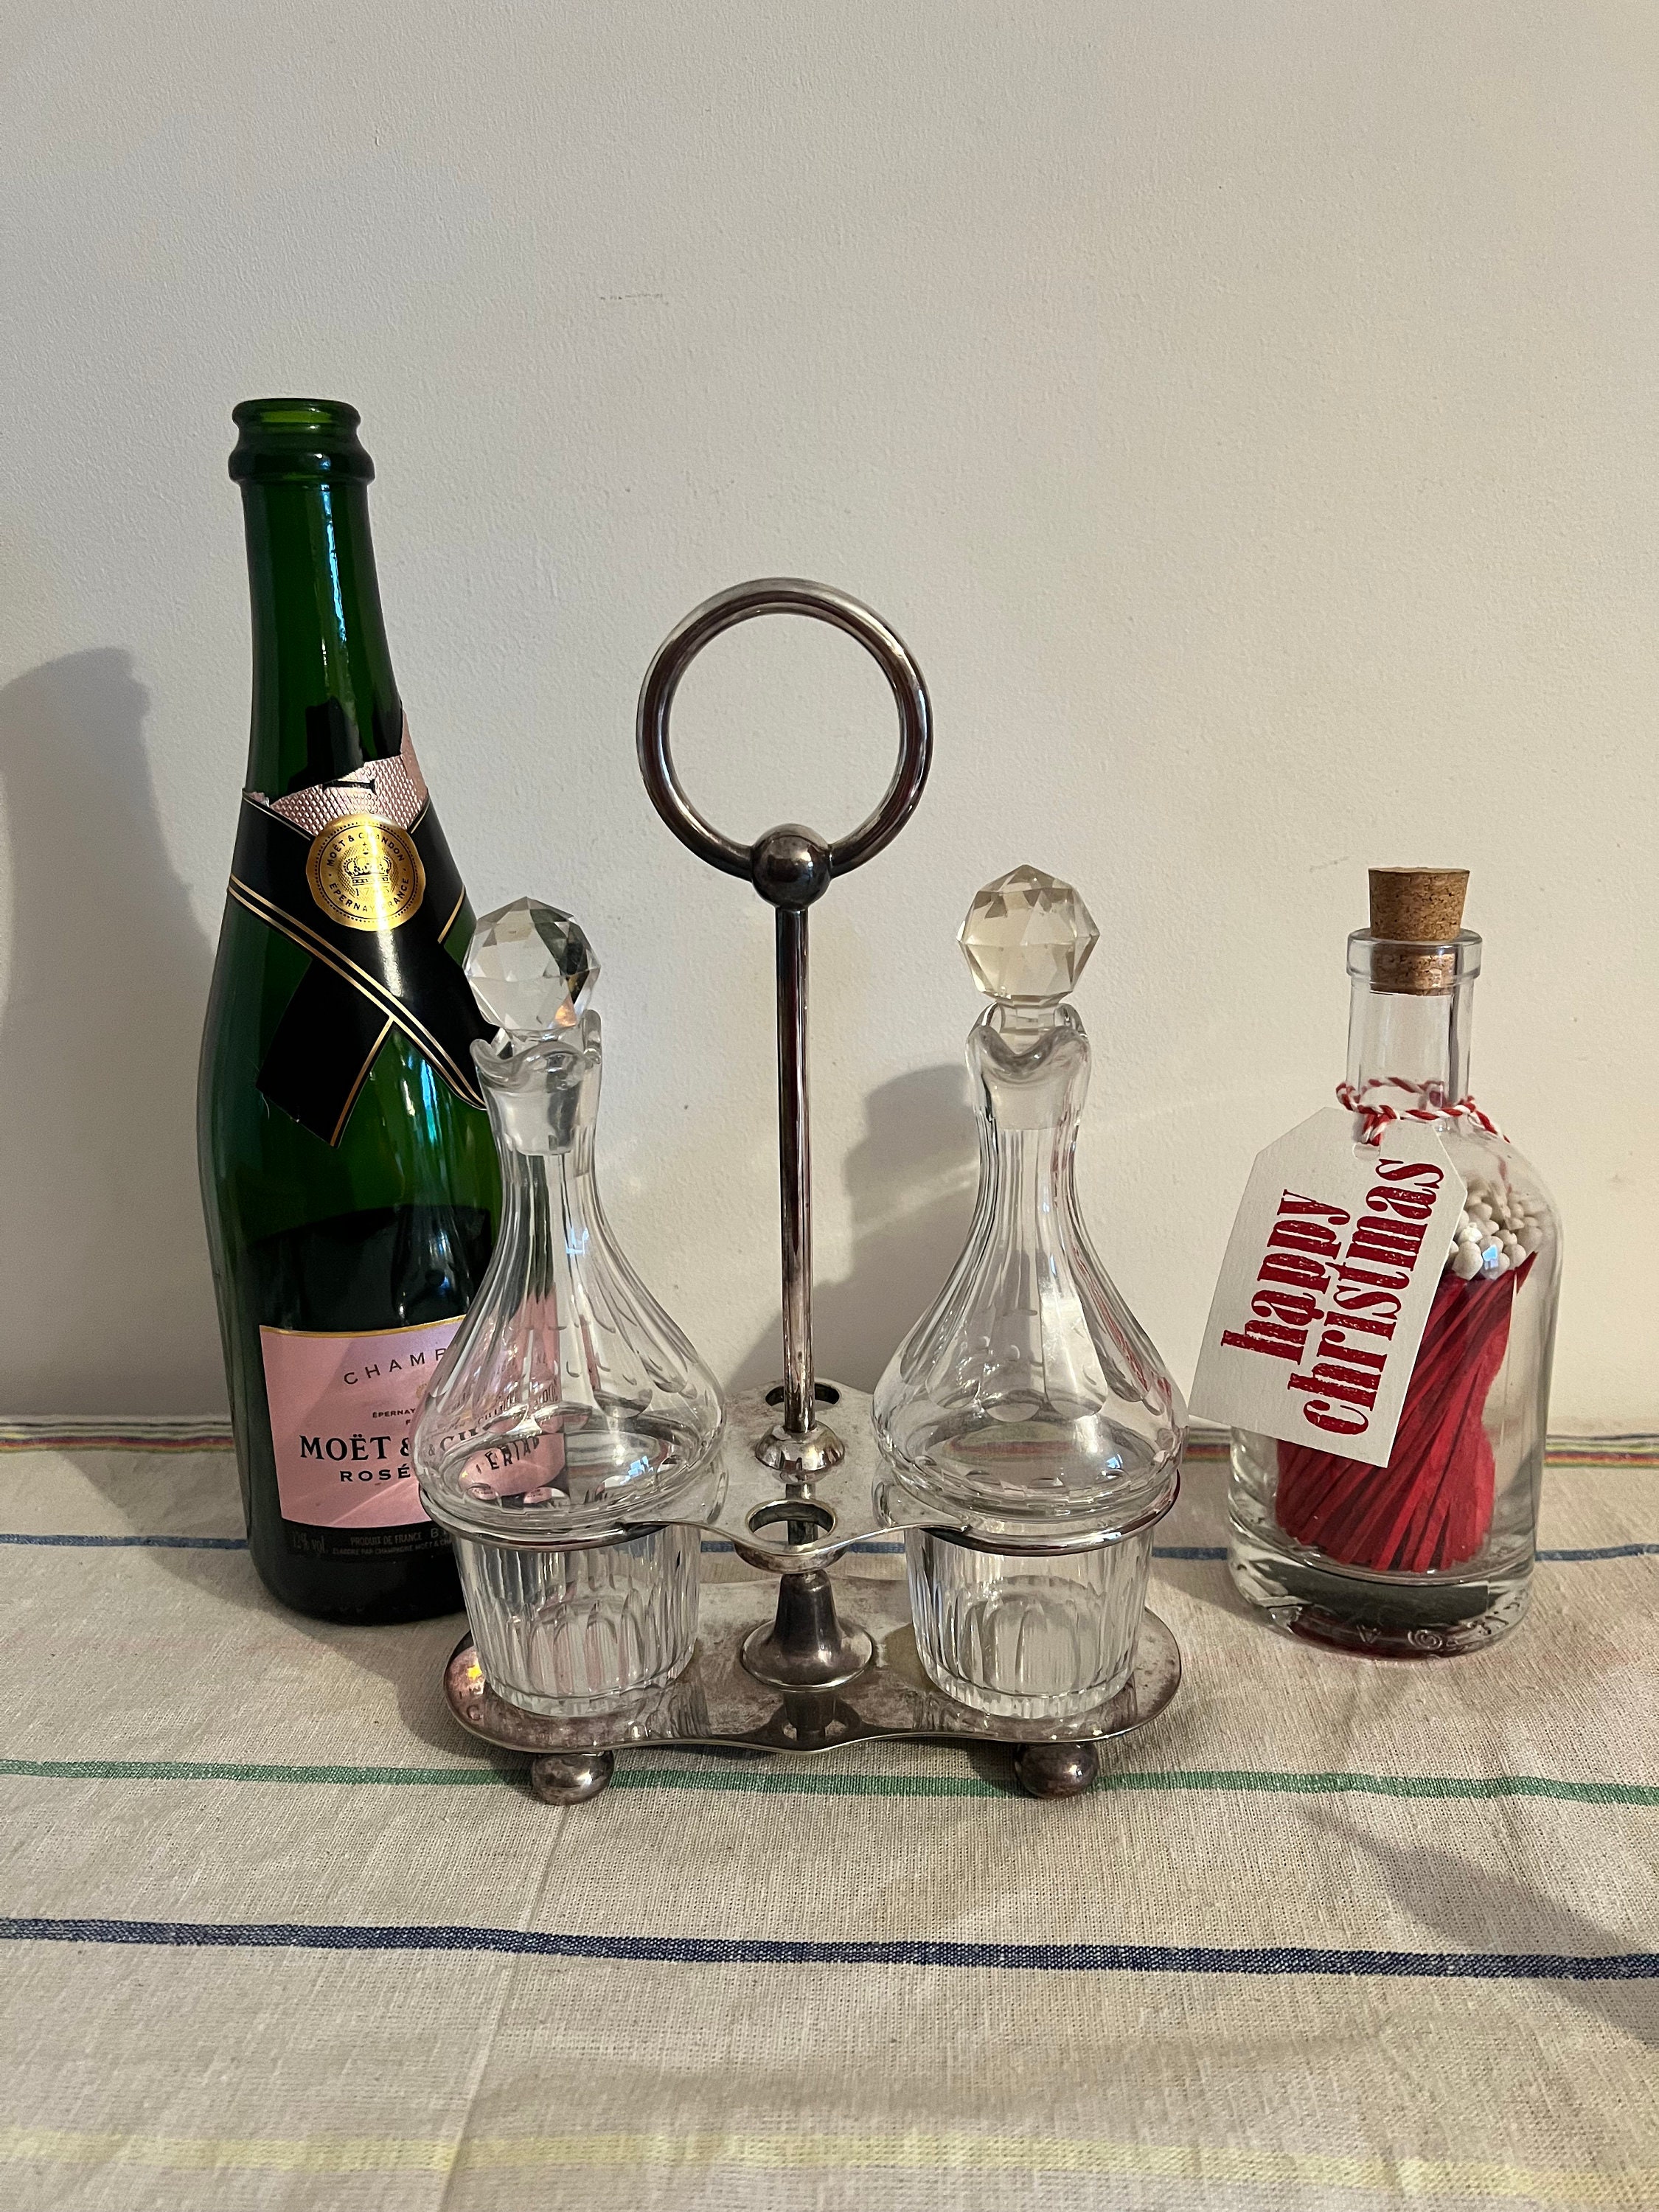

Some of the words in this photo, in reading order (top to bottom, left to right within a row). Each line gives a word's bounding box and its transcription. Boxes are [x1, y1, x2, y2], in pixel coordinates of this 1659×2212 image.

[358, 832, 405, 862] CANDON
[382, 878, 409, 910] RANCE
[1220, 1189, 1351, 1365] happy
[1287, 1158, 1444, 1435] christmas
[344, 1348, 447, 1385] CHAMP
[299, 1433, 391, 1461] MOËT
[339, 1463, 411, 1482] ROSÉ
[383, 1535, 393, 1545] DE
[394, 1531, 422, 1544] FRANCE
